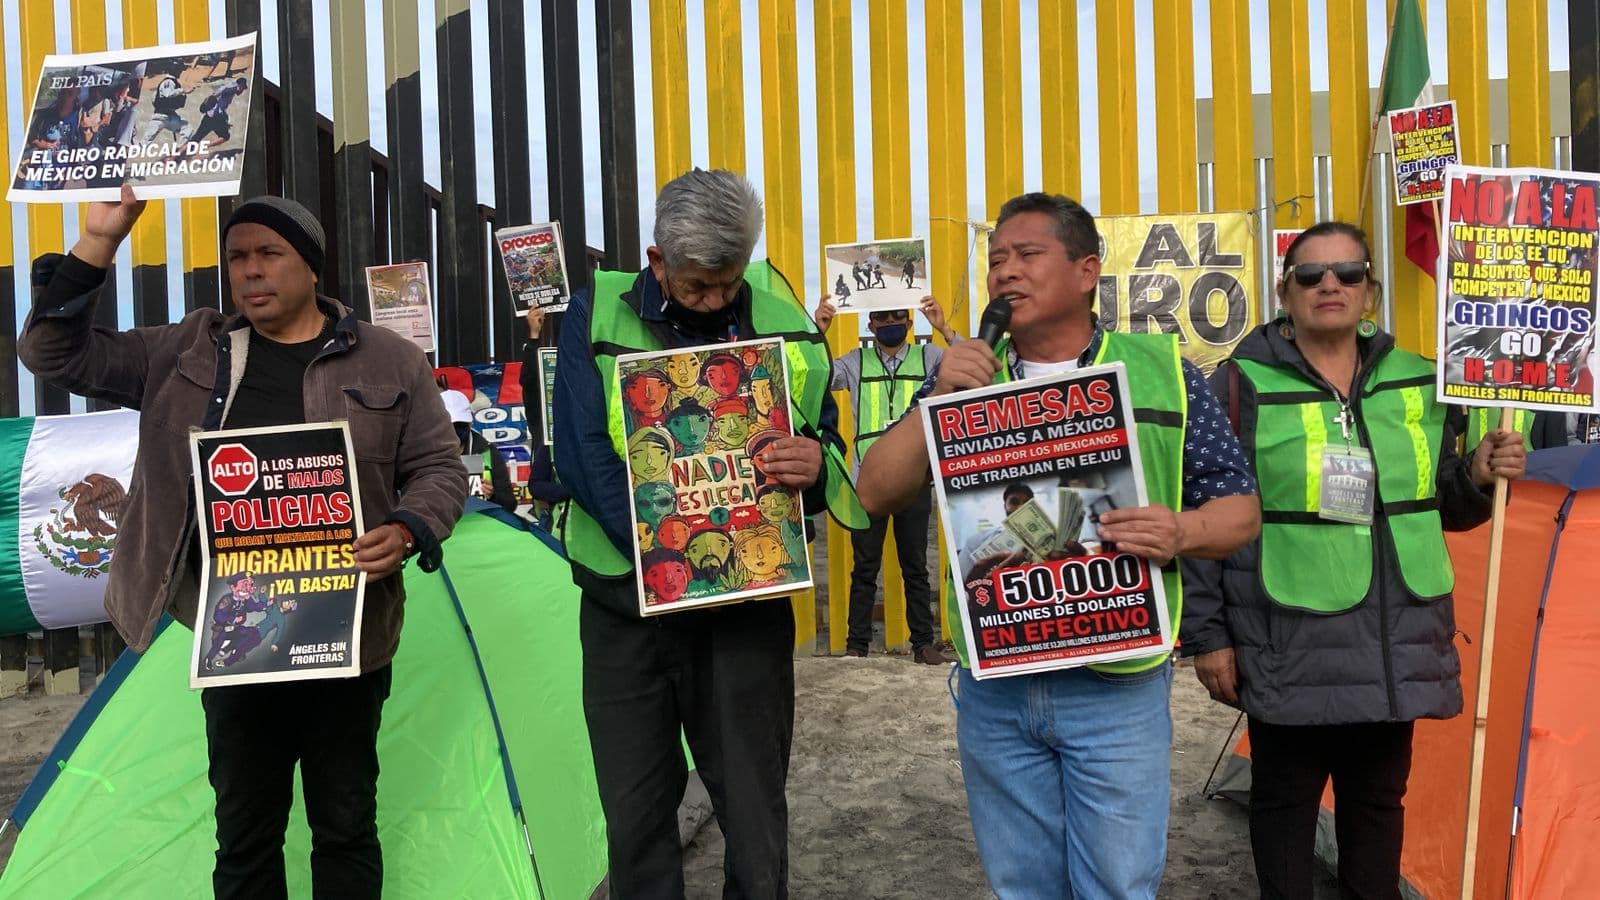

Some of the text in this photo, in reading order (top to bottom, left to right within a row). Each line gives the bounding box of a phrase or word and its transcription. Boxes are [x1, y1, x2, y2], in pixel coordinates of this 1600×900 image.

[49, 76, 73, 88] EL
[1391, 106, 1453, 134] NO A LA
[31, 140, 211, 164] EL GIRO RADICAL DE
[26, 155, 235, 182] MÉXICO EN MIGRACIÓN
[1400, 156, 1456, 174] GRINGOS
[1420, 170, 1438, 180] GO
[1450, 178, 1598, 230] NO A LA
[502, 233, 554, 254] proceso
[1134, 221, 1244, 270] AL
[1454, 224, 1593, 249] INTERVENCION
[1475, 245, 1492, 260] DE
[1496, 245, 1524, 262] LOS
[1454, 262, 1592, 285] EN ASUNTOS QUE SOLO
[1453, 278, 1591, 304] COMPETEN A MEXICO
[1454, 301, 1591, 334] GRINGOS
[1500, 332, 1542, 357] GO
[1464, 356, 1574, 388] HOME
[1446, 384, 1592, 406] ANGELES SIN FRONTERAS
[937, 379, 1114, 442] REMESAS
[944, 415, 1116, 458] ENVIADAS A MÉXICO
[261, 454, 344, 472] A LOS ABUSOS
[948, 458, 978, 472] CADA
[1004, 450, 1028, 462] POR
[1030, 446, 1051, 458] LOS
[1053, 434, 1119, 453] MEXICANOS
[214, 462, 254, 478] ALTO
[264, 469, 344, 490] DE MALOS
[671, 454, 753, 488] NADIE
[951, 474, 980, 490] QUE
[981, 460, 1053, 483] TRABAJAN
[1056, 455, 1076, 472] EN
[212, 492, 353, 532] POLICIAS
[677, 490, 700, 512] ES
[215, 538, 233, 548] QUE
[234, 535, 265, 546] ROBAN
[266, 534, 272, 544] Y
[326, 530, 334, 540] A
[335, 529, 352, 539] LOS
[217, 543, 356, 578] MIGRANTES
[269, 574, 356, 598] ¡YA BASTA!
[976, 552, 1144, 608] $ 50,000
[980, 592, 1146, 628] MILLONES DE DOLARES
[981, 606, 1150, 649] EN EFECTIVO
[288, 640, 346, 656] ÁNGELES SIN
[985, 648, 1009, 658] HACIENDA
[1009, 646, 1032, 654] RECAUDA
[1067, 636, 1091, 646] MILLONES
[1098, 633, 1121, 642] DOLARES
[1120, 631, 1132, 639] POR
[1029, 652, 1064, 662] FRONTERAS
[1070, 648, 1094, 657] ALIANZA
[1096, 644, 1126, 652] MIGRANTE
[1128, 640, 1153, 648] TIJUANA
[292, 652, 344, 666] FRONTERAS
